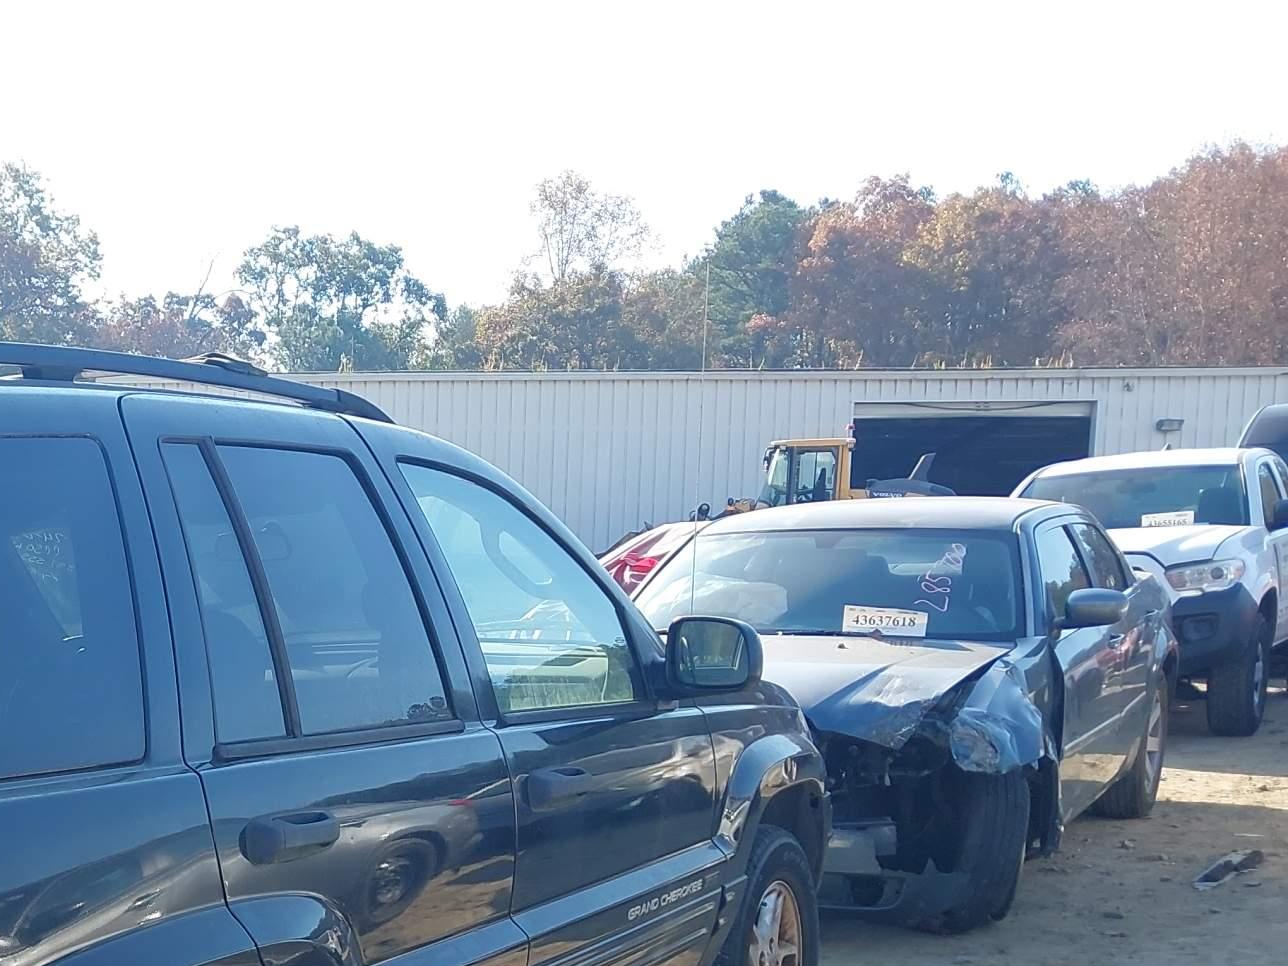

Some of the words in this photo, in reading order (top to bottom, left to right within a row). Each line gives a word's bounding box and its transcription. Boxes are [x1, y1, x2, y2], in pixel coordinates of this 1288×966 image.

[852, 614, 917, 627] 43637618
[627, 897, 659, 921] GRAND
[660, 878, 704, 906] CHEROKEE
